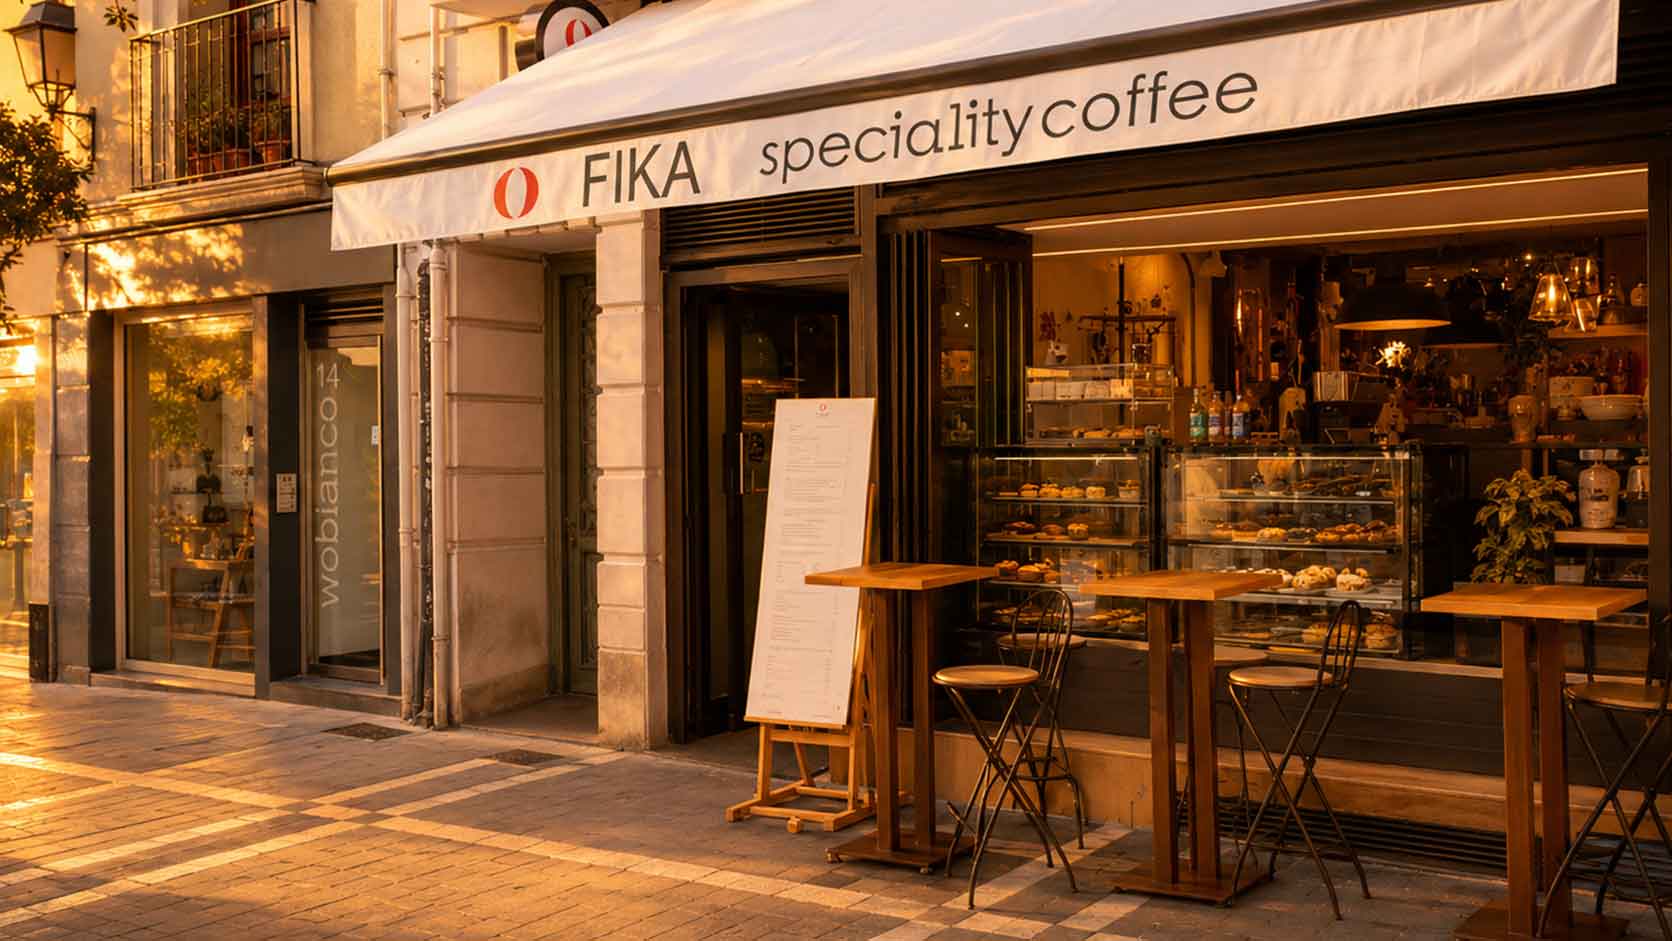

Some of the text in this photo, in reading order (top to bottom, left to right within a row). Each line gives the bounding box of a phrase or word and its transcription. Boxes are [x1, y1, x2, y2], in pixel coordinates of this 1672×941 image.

[582, 70, 1258, 208] FIKA speciality coffee
[316, 362, 341, 389] 14
[315, 396, 339, 609] wobianco
